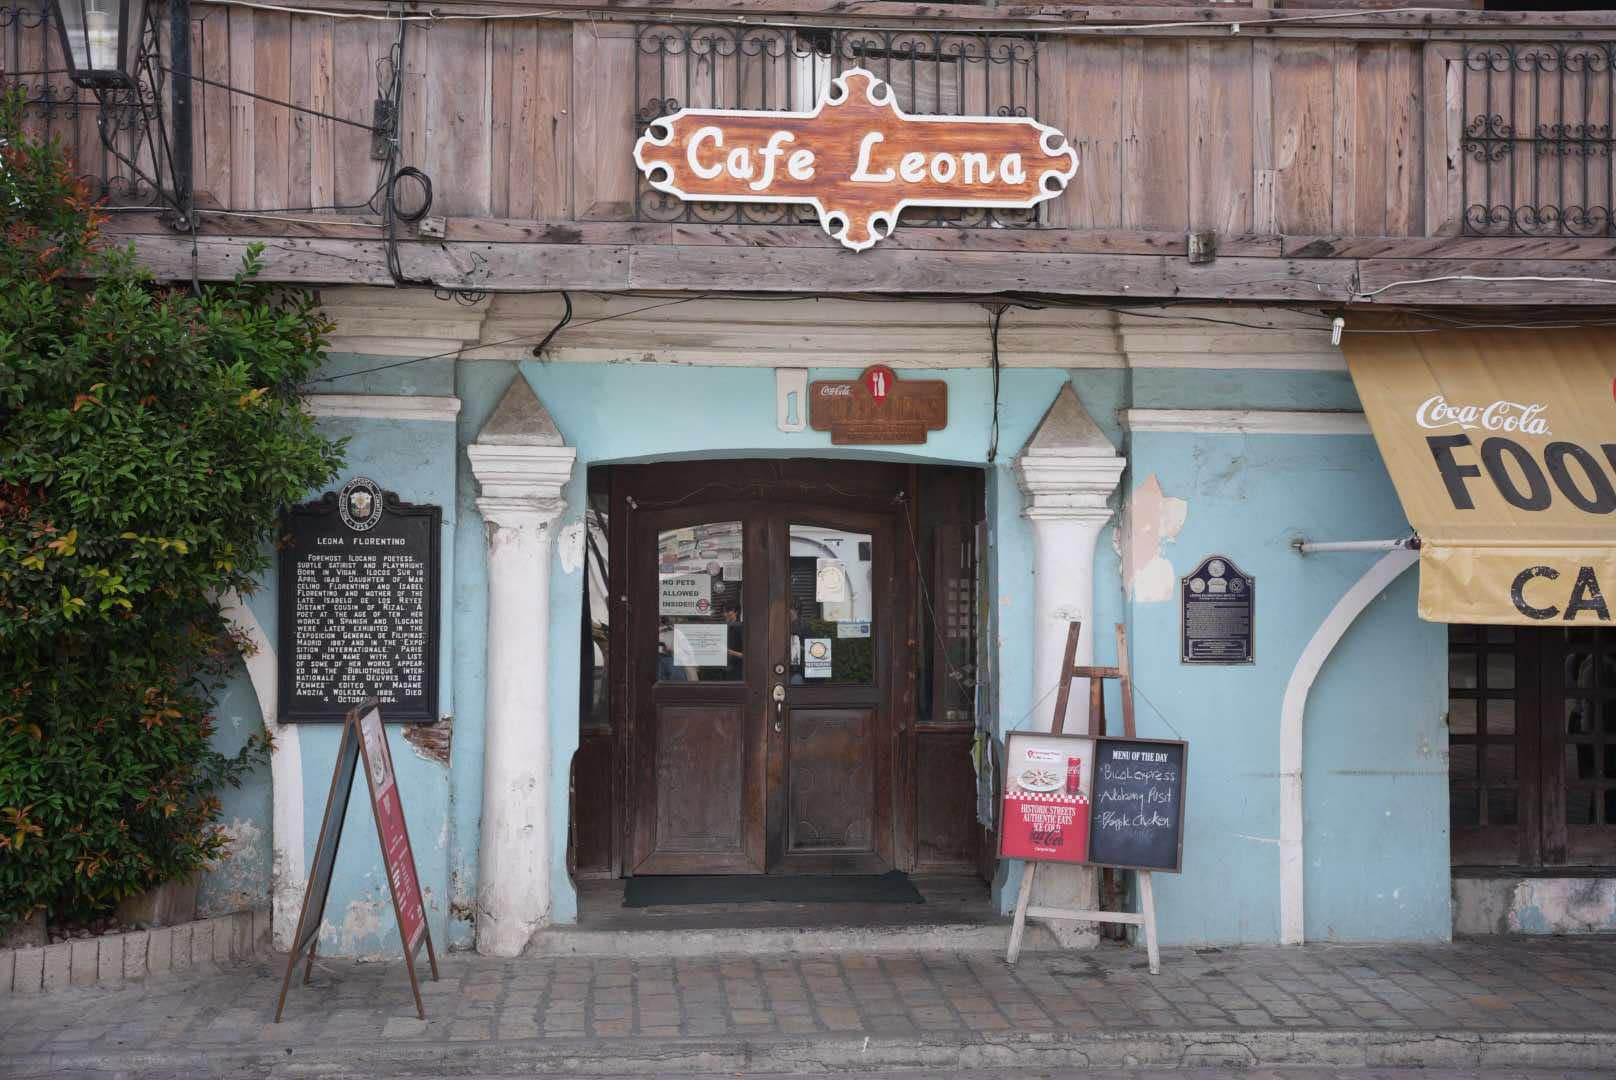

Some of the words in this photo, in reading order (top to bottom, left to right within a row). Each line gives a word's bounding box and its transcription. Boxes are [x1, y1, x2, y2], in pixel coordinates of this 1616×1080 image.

[686, 126, 816, 192] Cafe
[850, 132, 1027, 185] Leona
[1416, 395, 1552, 435] Coca-Cola
[317, 537, 344, 545] LEONA
[353, 537, 406, 545] FLORENTINO
[1112, 750, 1130, 760] MENU
[1132, 752, 1140, 760] OF
[1141, 752, 1154, 761] THE
[1156, 753, 1168, 762] DAY
[1021, 804, 1049, 814] HISTORIC
[1050, 806, 1075, 816] STREETS
[1024, 813, 1055, 824] AUTHENTIC
[1058, 816, 1072, 825] EATS
